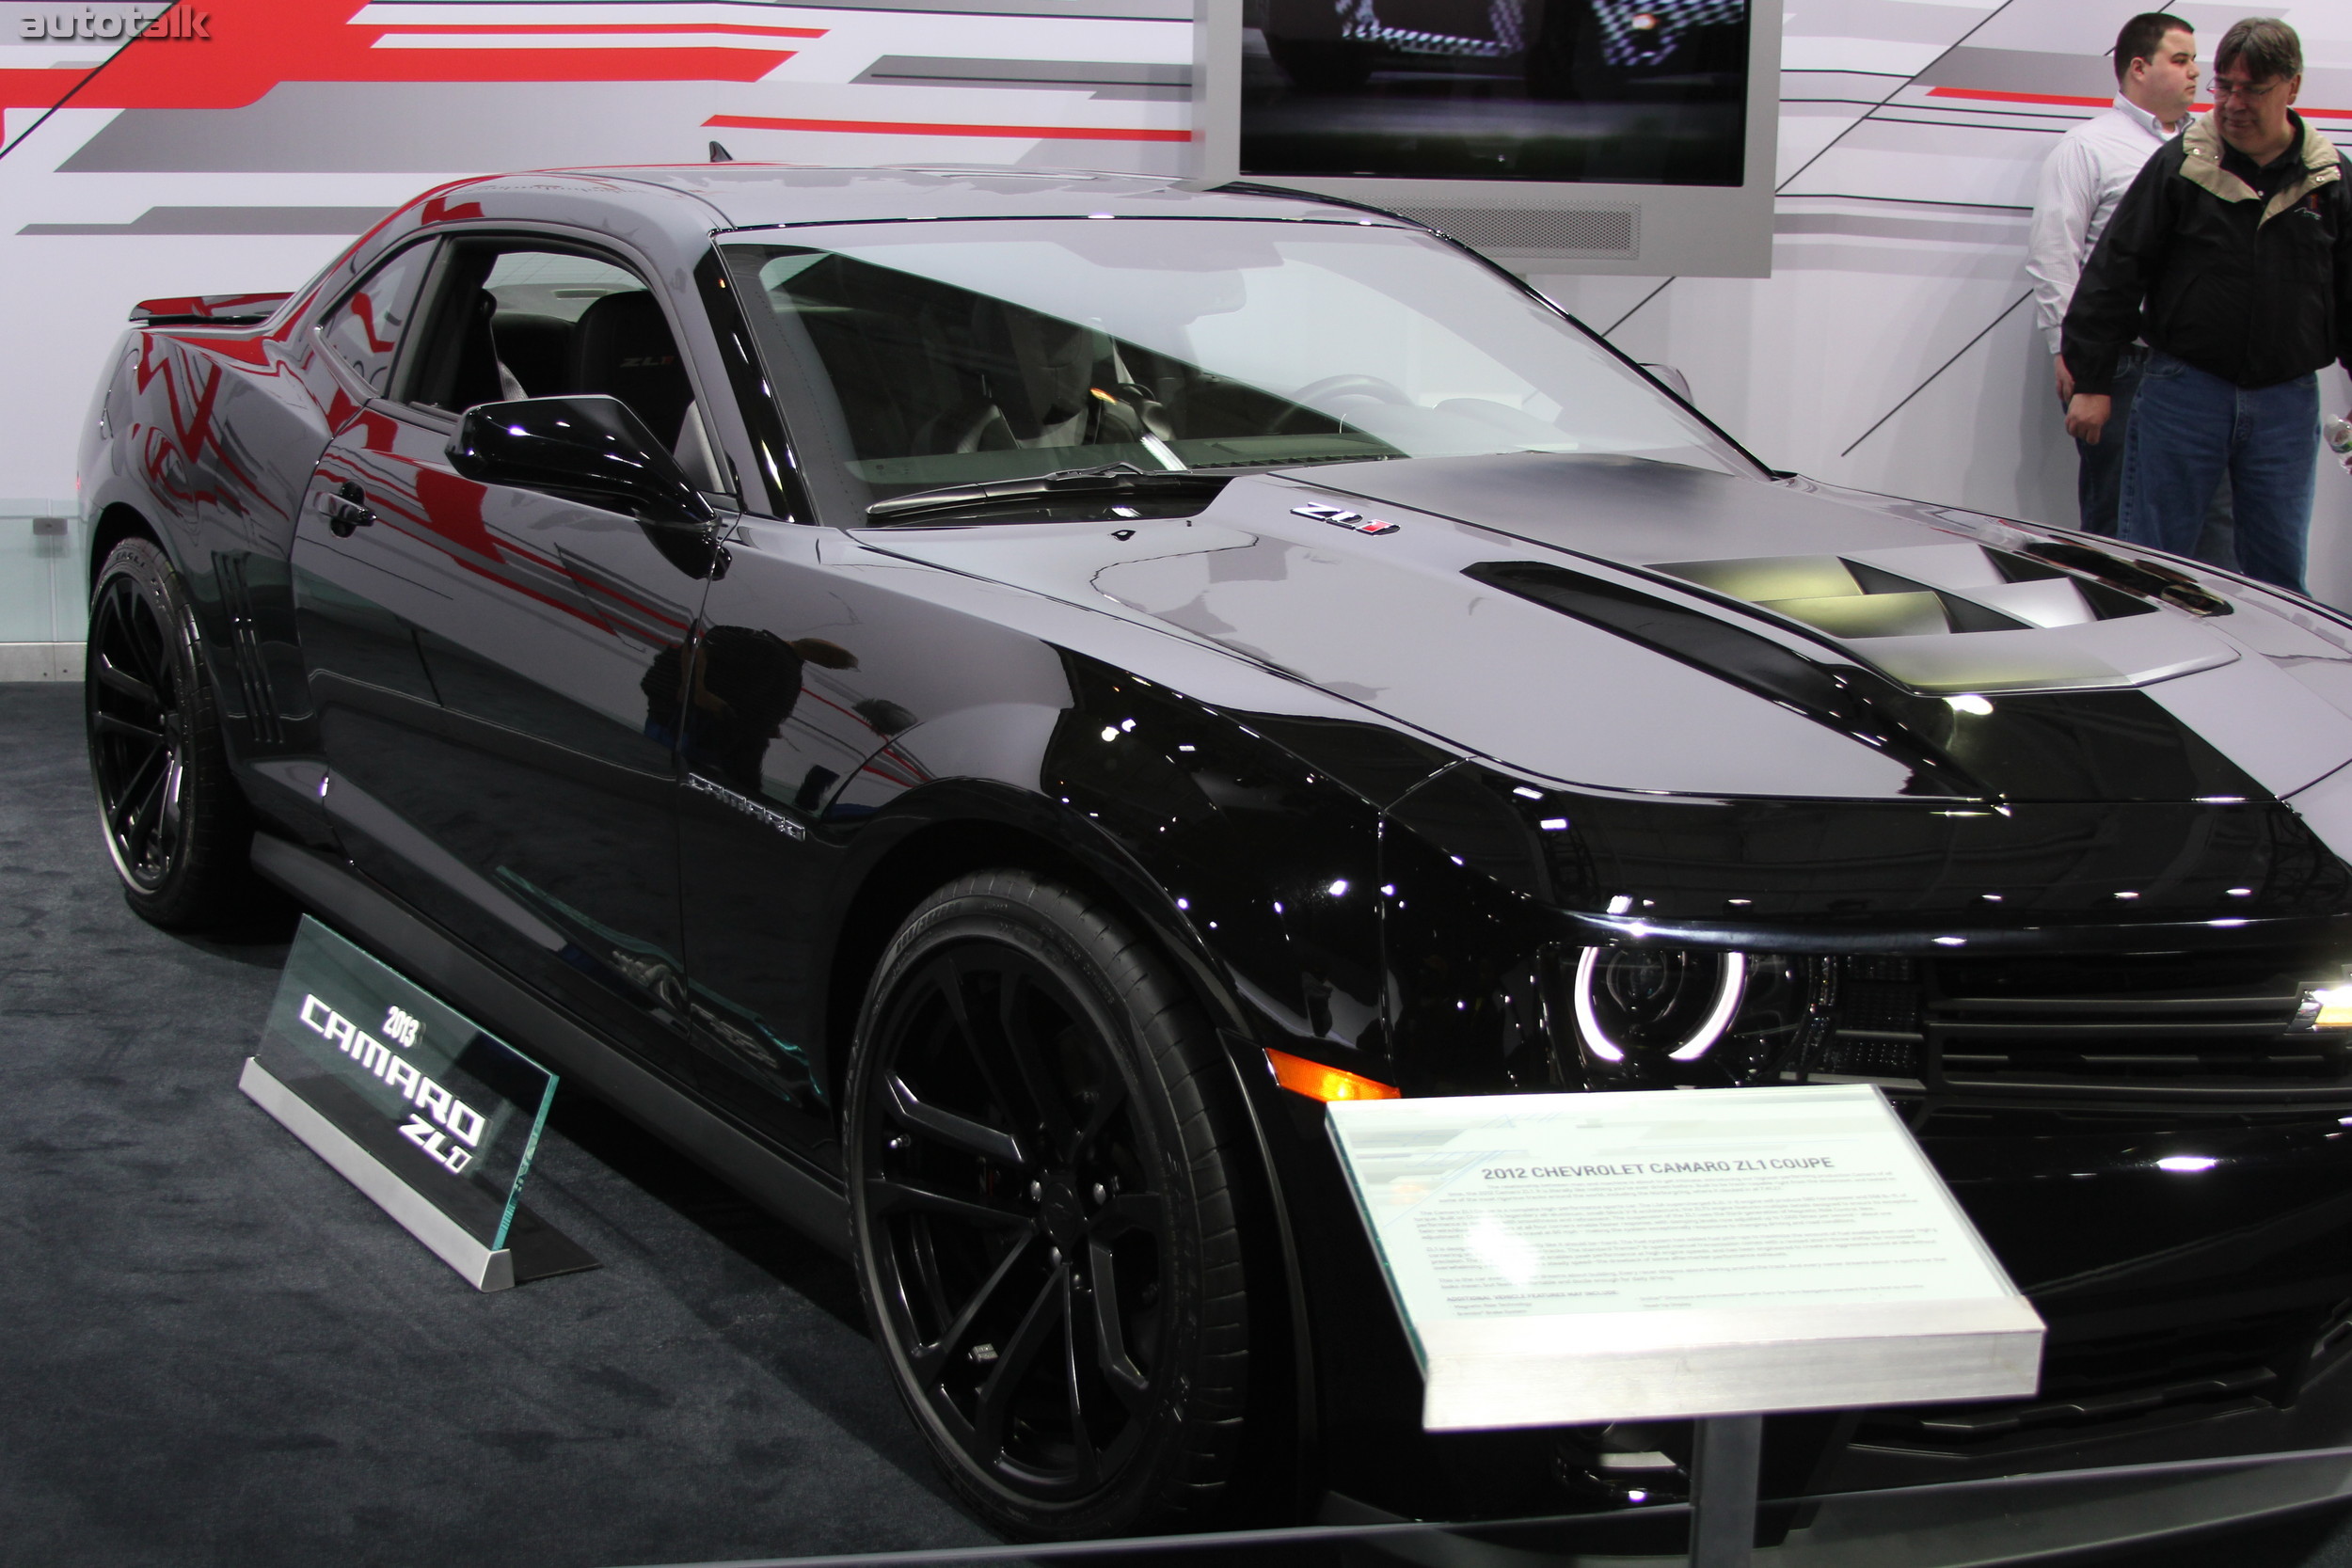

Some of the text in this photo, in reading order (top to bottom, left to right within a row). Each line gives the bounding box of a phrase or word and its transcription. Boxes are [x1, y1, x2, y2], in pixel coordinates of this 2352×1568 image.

[1290, 501, 1401, 536] ZL1
[689, 771, 806, 842] CAMARO
[382, 1005, 421, 1048] 2013
[299, 993, 487, 1148] CAMARO
[399, 1113, 473, 1174] ZL1
[1482, 1156, 1836, 1180] 2012 CHEVROLET CAMARO ZL1 COUPE
